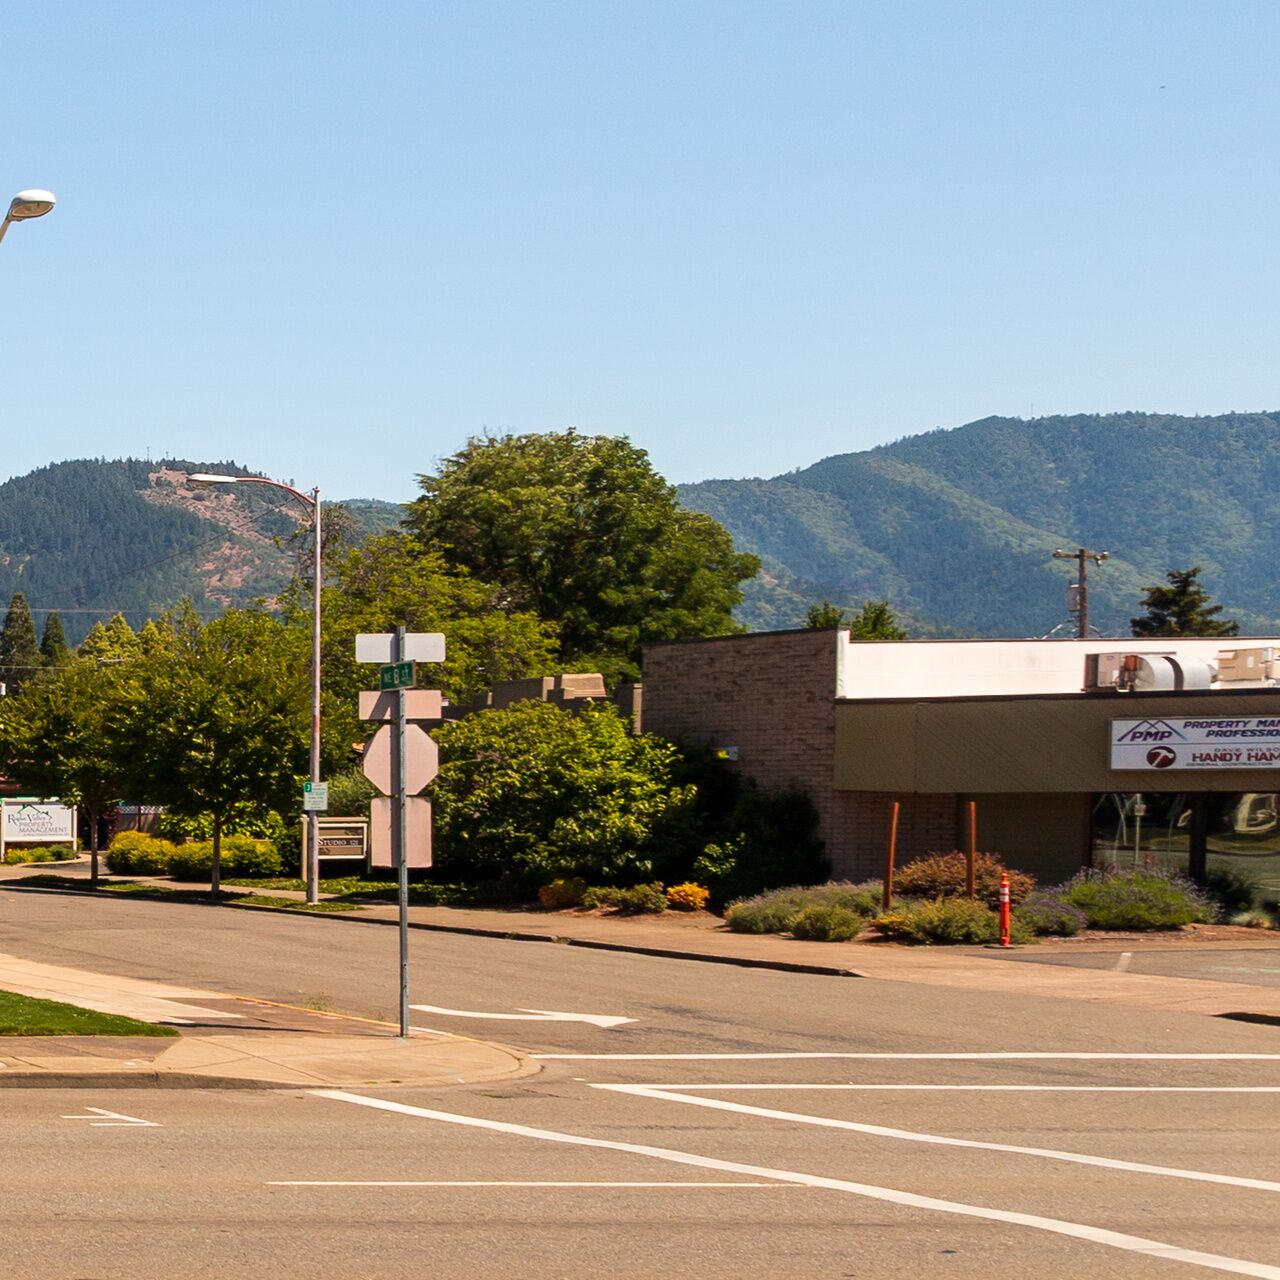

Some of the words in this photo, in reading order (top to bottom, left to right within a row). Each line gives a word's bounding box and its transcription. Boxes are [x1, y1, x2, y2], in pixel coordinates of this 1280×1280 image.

[1183, 720, 1251, 729] PROPERTY
[1130, 730, 1173, 742] PMP
[1205, 729, 1280, 738] PROFESSIO
[1192, 752, 1243, 762] HANDY
